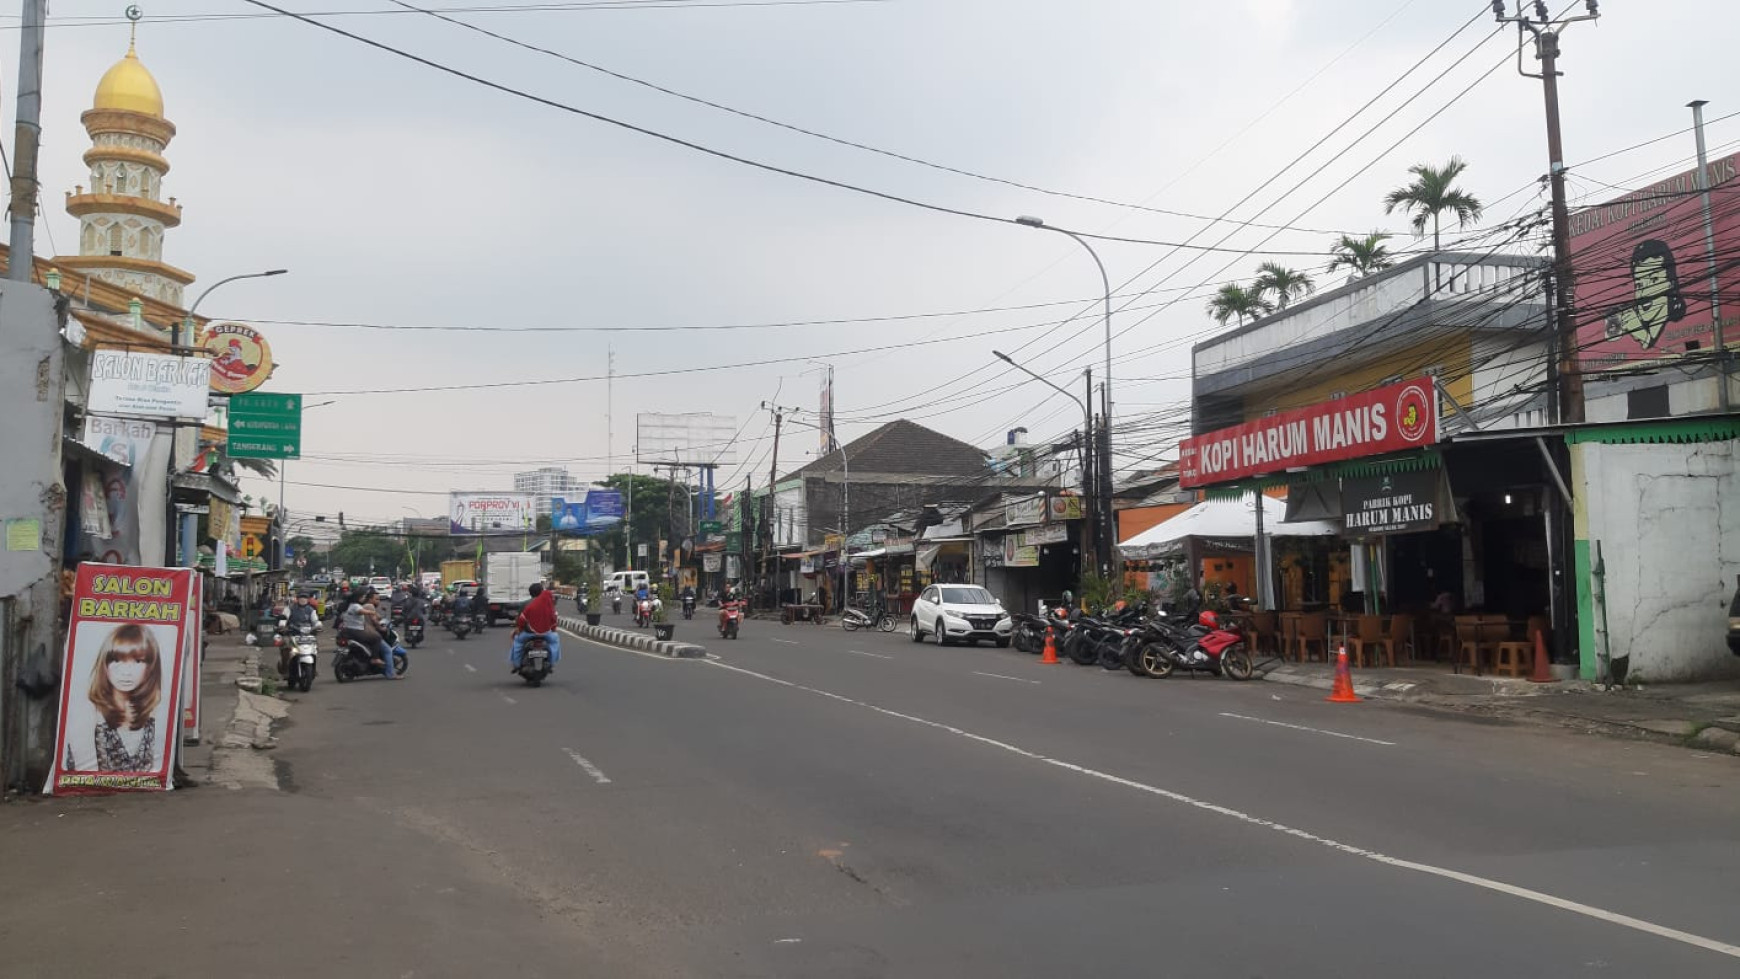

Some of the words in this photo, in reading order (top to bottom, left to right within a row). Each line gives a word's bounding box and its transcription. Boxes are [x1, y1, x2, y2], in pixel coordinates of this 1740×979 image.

[1568, 206, 1606, 237] KEDAI
[1690, 157, 1737, 192] MNIS
[94, 353, 144, 381] SALON
[146, 358, 211, 387] BARKAH
[91, 418, 151, 439] Barkah
[1201, 438, 1238, 475] KOPI
[1242, 419, 1308, 467] HARUM
[1313, 402, 1387, 452] MANIS
[232, 442, 278, 452] TANGERANG
[469, 500, 510, 510] PORPROV
[1363, 496, 1391, 510] PABRIK
[1392, 493, 1412, 507] KOPI
[1346, 508, 1388, 528] HARUM
[1392, 503, 1433, 523] MANIS
[93, 575, 172, 597] SALON
[79, 597, 180, 621] BARKAH
